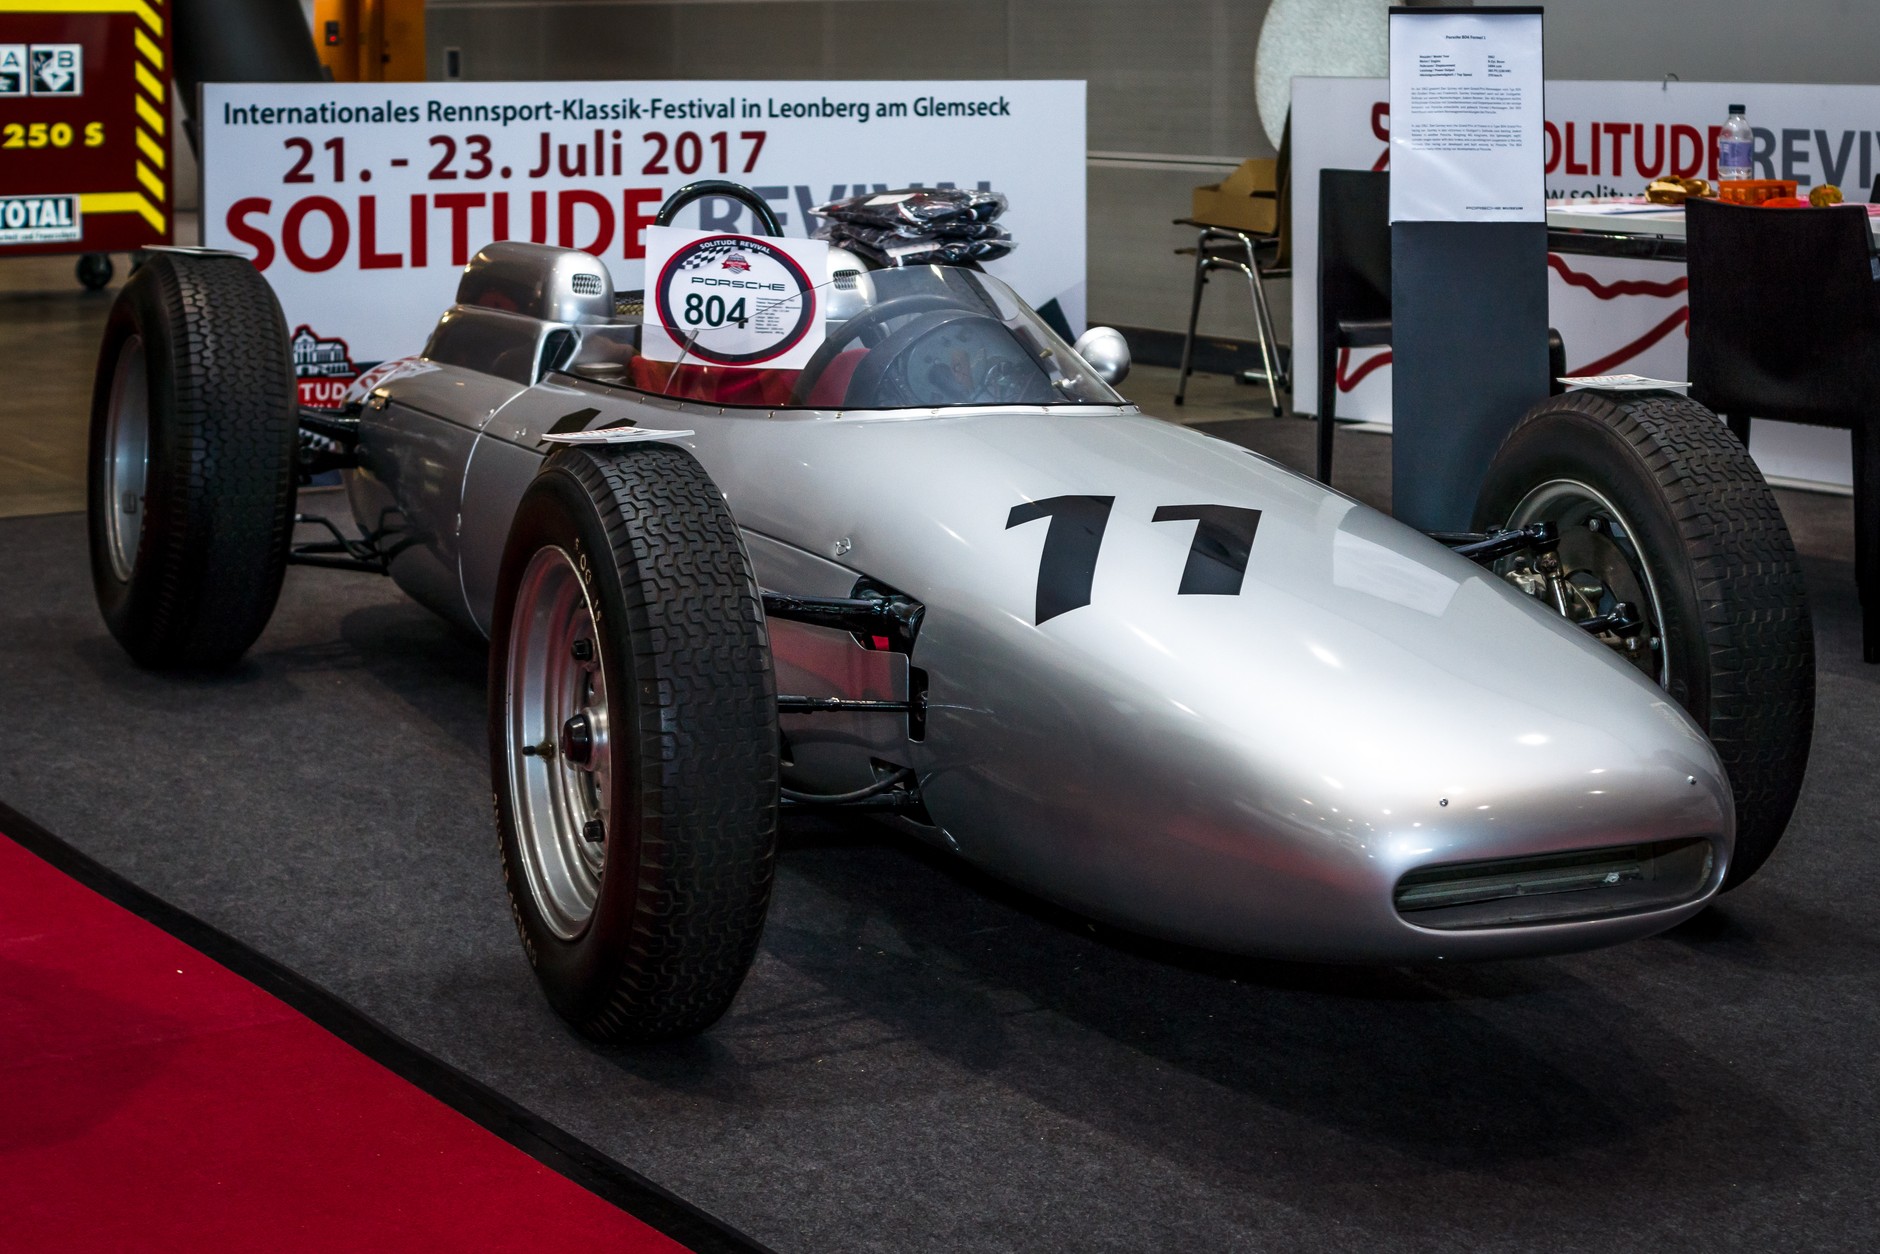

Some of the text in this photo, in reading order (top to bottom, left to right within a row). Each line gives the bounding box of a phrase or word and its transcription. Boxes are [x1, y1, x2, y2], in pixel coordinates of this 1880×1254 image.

[3, 51, 20, 67] A
[58, 51, 73, 67] B
[223, 96, 1011, 126] Internationales Rennsport-Klassik-Festival in Leonberg am Glemseck
[2, 122, 105, 148] 250 S
[283, 129, 767, 183] 21. - 23. Juli 2017
[1749, 127, 1880, 189] REVI
[225, 188, 663, 273] SOLITUDE
[699, 239, 771, 254] SOLITUDE REVIVAL
[691, 276, 786, 292] PORSCHE
[684, 292, 749, 329] 804
[300, 382, 346, 401] TUD
[1005, 495, 1262, 626] 11
